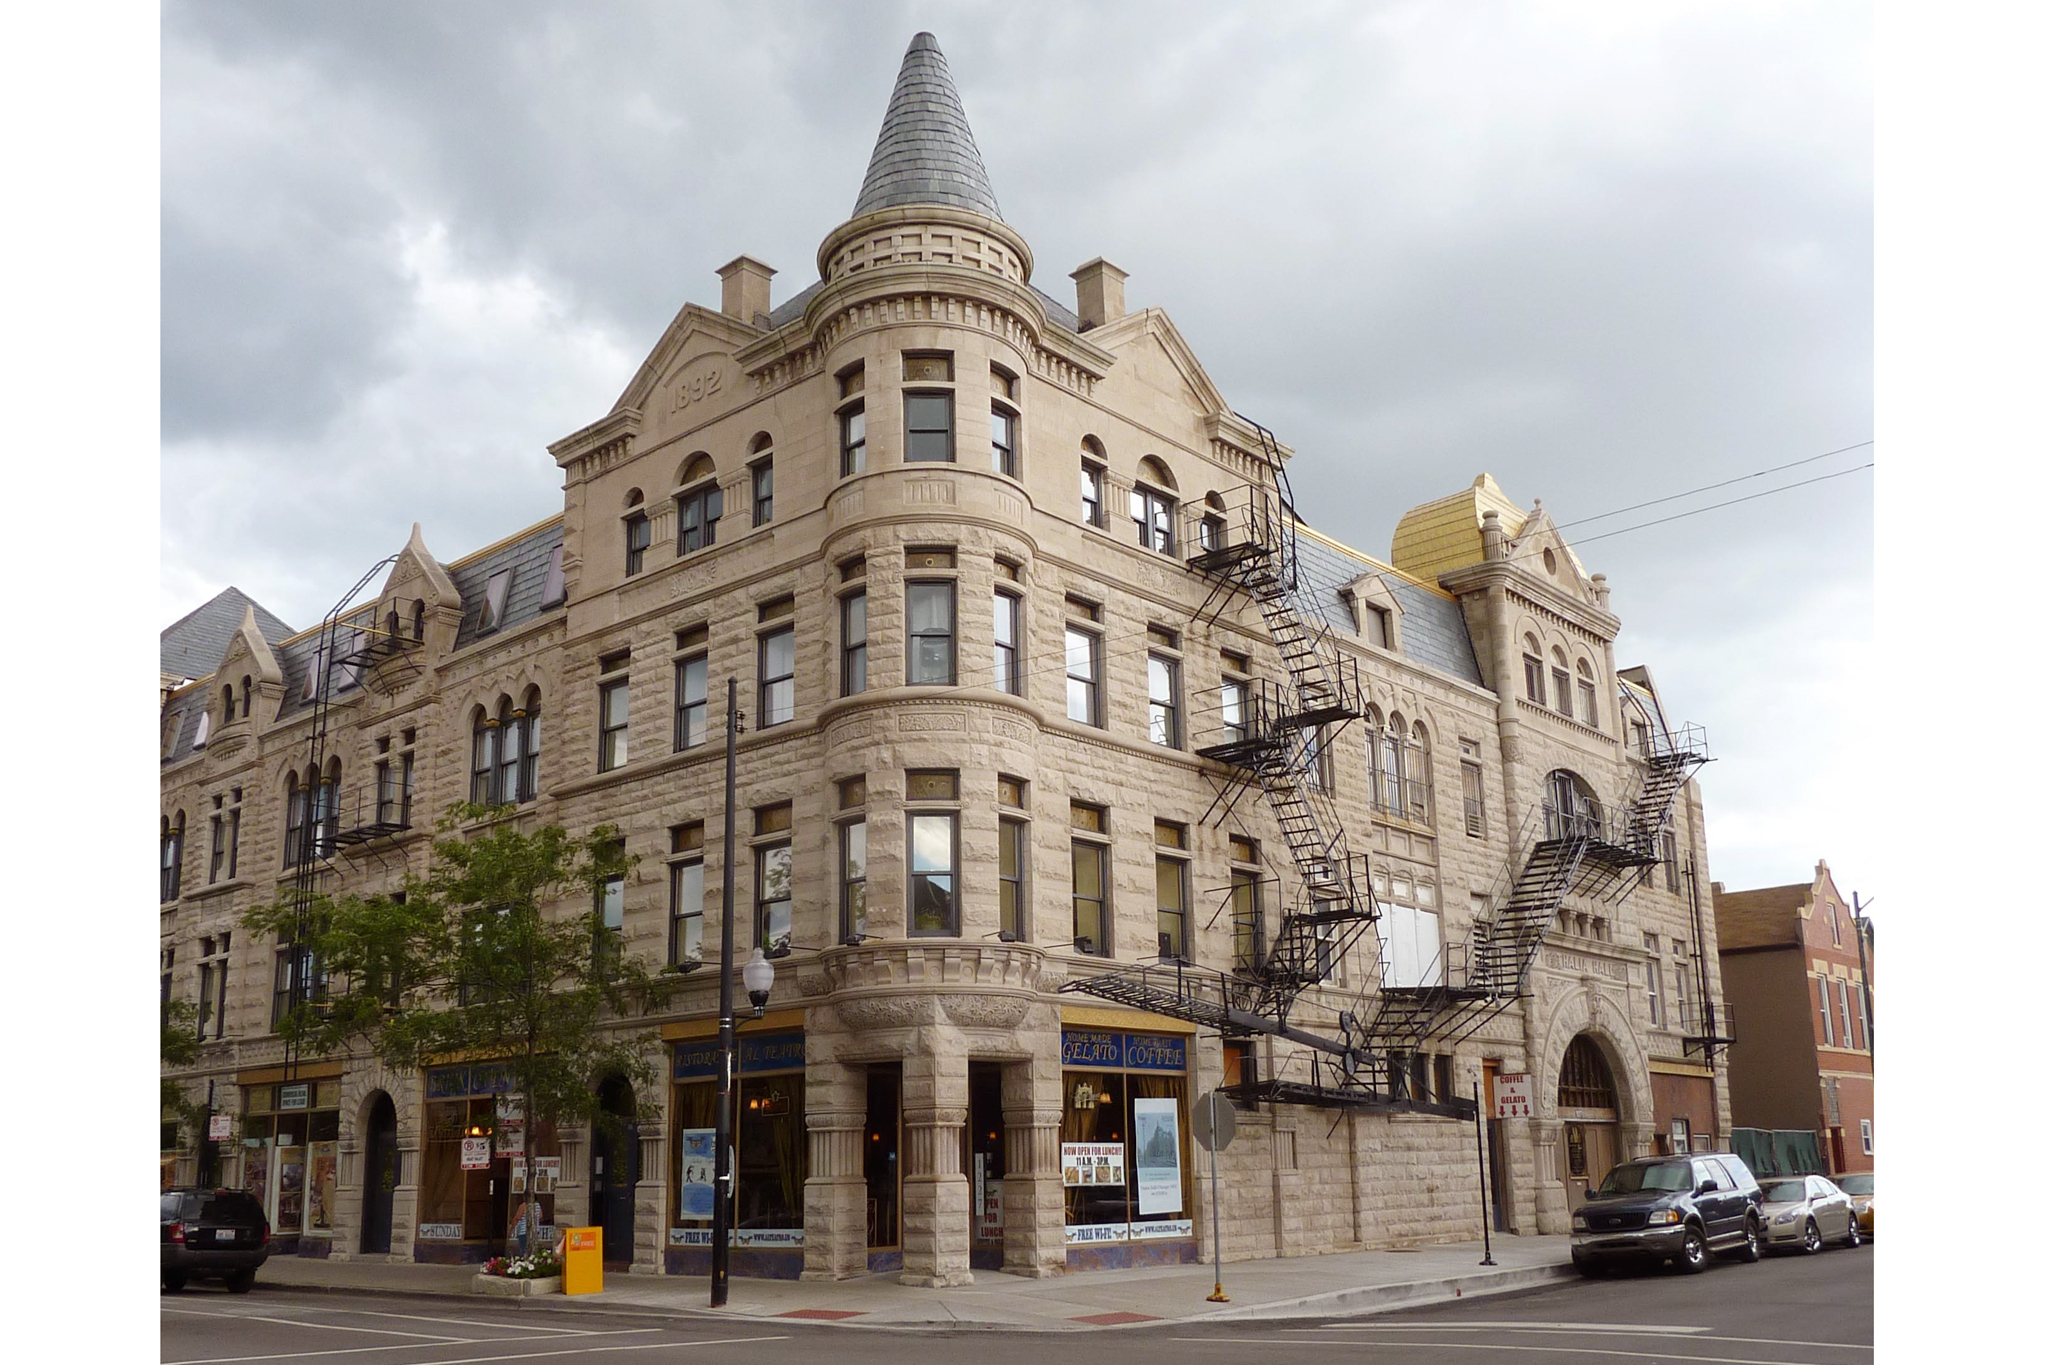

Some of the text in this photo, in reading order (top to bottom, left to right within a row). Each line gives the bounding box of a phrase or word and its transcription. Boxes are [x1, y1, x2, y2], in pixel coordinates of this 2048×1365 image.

[667, 366, 724, 414] 1892
[1592, 959, 1615, 977] HALL
[1067, 1032, 1112, 1044] HOME MADE
[675, 1047, 738, 1067] RISTORAE
[1062, 1042, 1118, 1064] GELATO
[1128, 1046, 1183, 1065] COFFEE
[1500, 1075, 1524, 1084] COFFEE
[1501, 1096, 1526, 1104] GELATO
[1064, 1146, 1076, 1156] NOW
[1077, 1146, 1091, 1156] OPEN
[1091, 1146, 1101, 1156] FOR
[1076, 1156, 1081, 1166] 11
[985, 1212, 998, 1223] FOR
[430, 1224, 462, 1238] SUNDAY
[685, 1231, 701, 1244] FREE
[981, 1226, 1004, 1237] LUNCH
[1077, 1228, 1094, 1241] FREE
